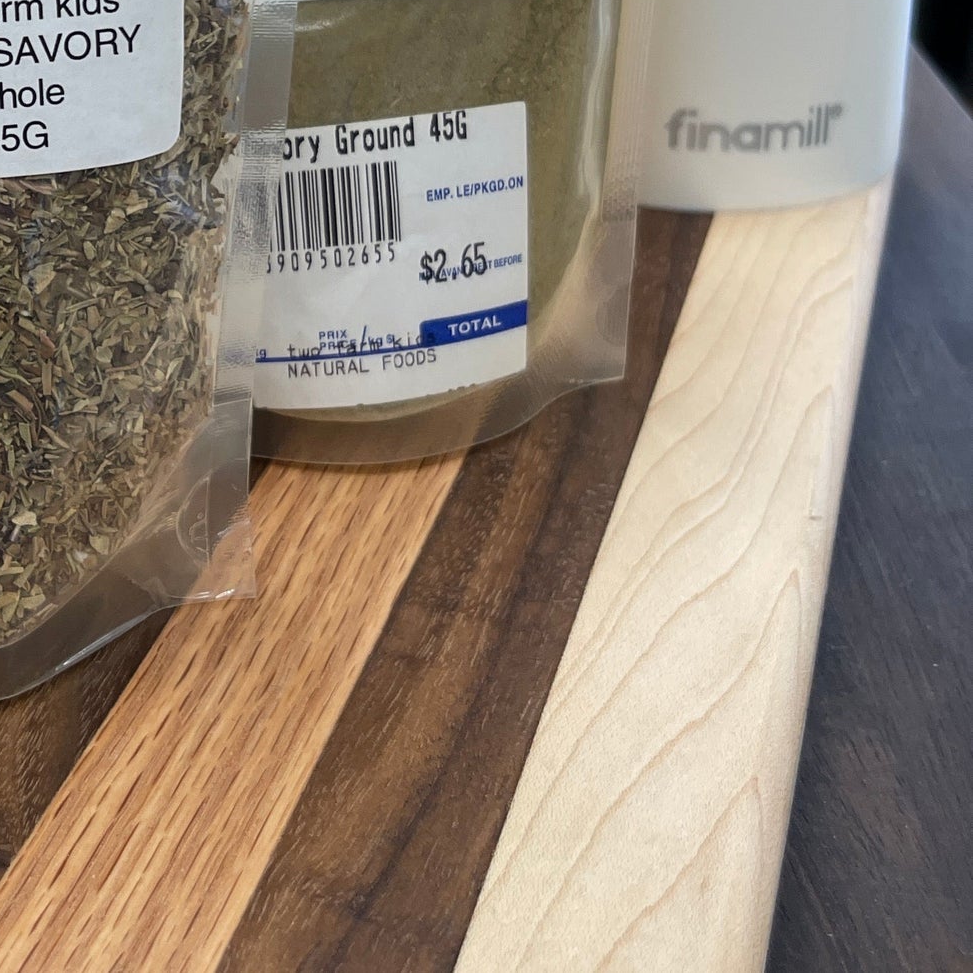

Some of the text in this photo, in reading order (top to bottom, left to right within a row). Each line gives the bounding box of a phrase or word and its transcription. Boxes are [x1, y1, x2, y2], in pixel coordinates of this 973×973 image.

[334, 116, 416, 155] Ground
[429, 110, 468, 143] 45G
[426, 187, 454, 202] EMP.
[419, 241, 486, 286] $2.65
[493, 253, 523, 269] BEFORE
[318, 329, 348, 340] PRIX
[447, 314, 502, 337] TOTAL
[287, 348, 438, 379] NATURAL FOODS
